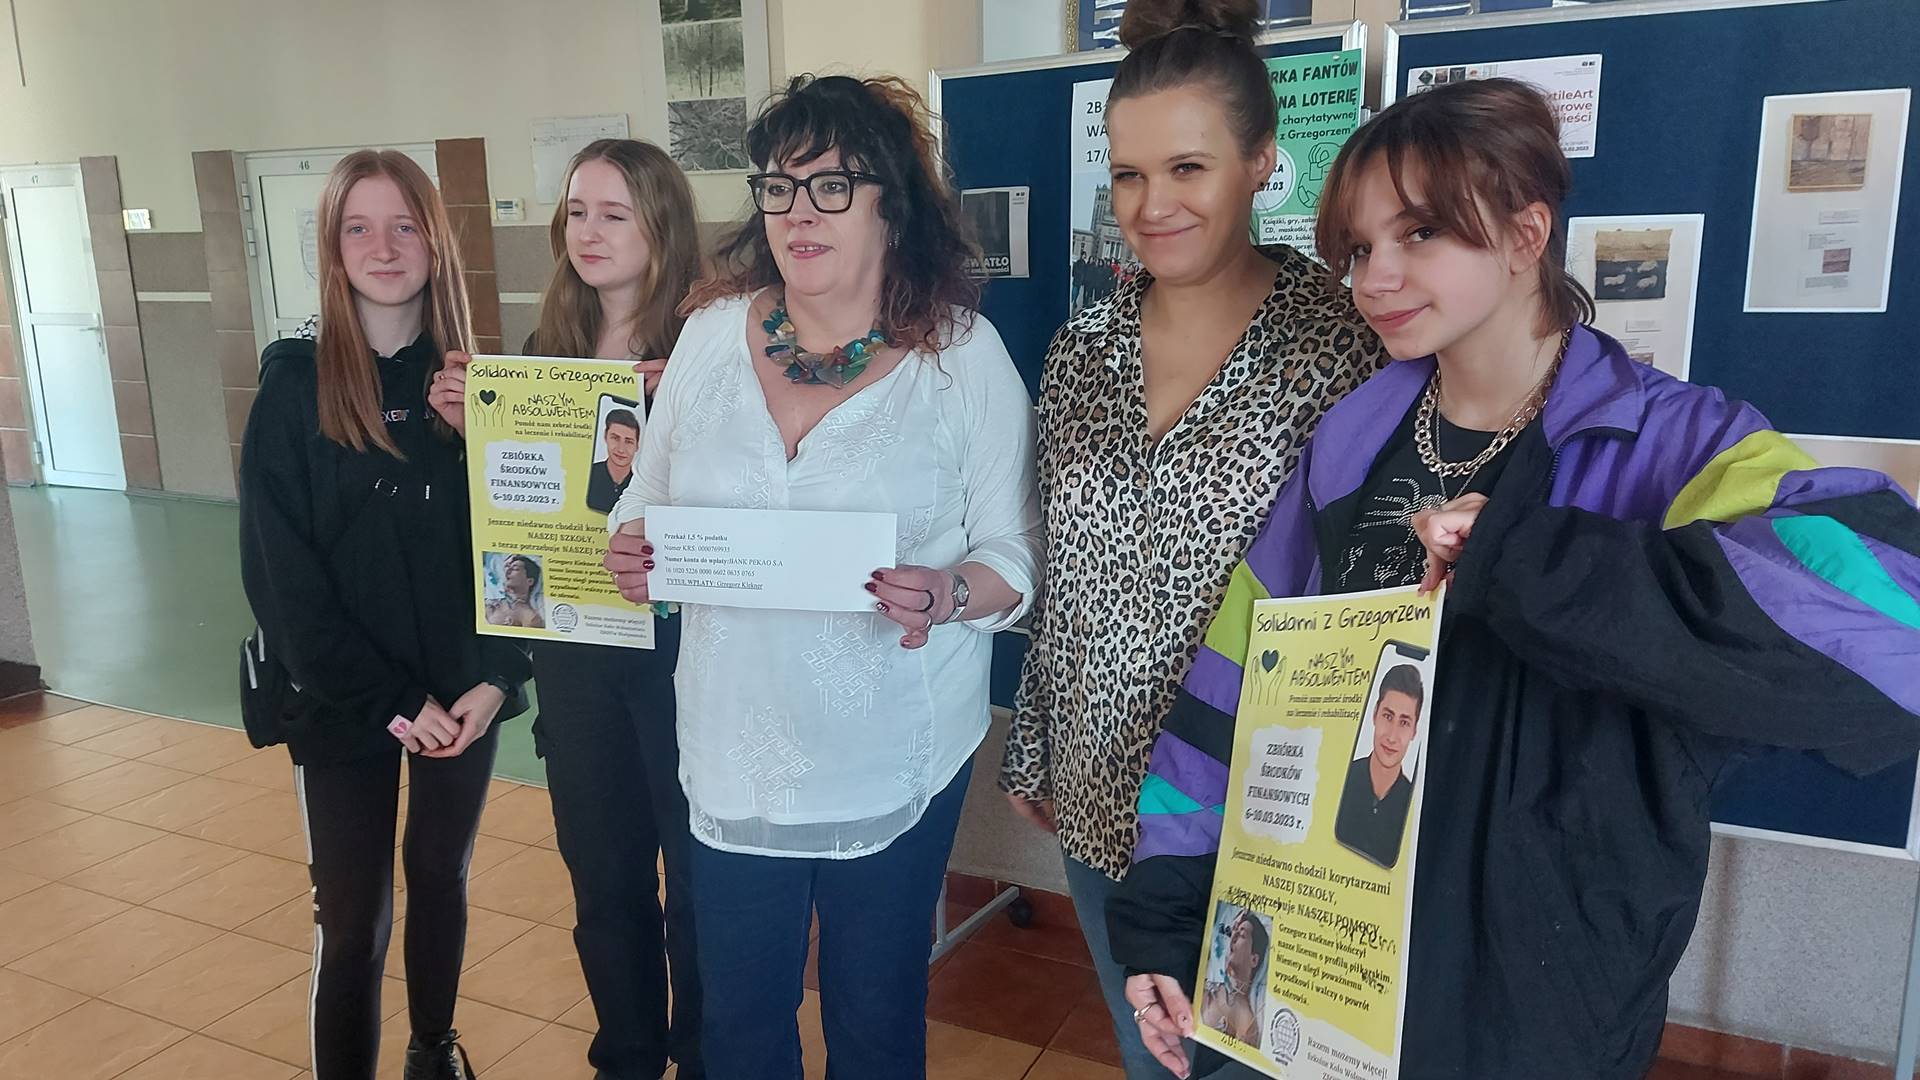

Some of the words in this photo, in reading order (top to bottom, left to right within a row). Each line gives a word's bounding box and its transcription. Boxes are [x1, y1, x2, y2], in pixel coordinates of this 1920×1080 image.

[1303, 58, 1358, 81] FANTÓW
[1279, 94, 1296, 109] NA
[1302, 88, 1357, 107] LOTERIĘ
[1283, 108, 1356, 125] charytatywnej
[298, 160, 310, 170] 46
[471, 364, 529, 379] Solidarni
[534, 368, 543, 379] z
[549, 367, 635, 392] Grzegorzem
[528, 393, 575, 406] NASZYM
[512, 403, 596, 419] ABSOLWENTEM
[502, 451, 544, 461] ZBIÓRKA
[500, 463, 548, 475] ŚRODKÓW
[490, 479, 560, 490] FINANSOWYCH
[517, 519, 553, 529] niedawno
[528, 532, 558, 542] NASZEJ
[1257, 611, 1317, 632] Solidarni
[1323, 613, 1333, 630] z
[1339, 604, 1430, 641] Grzegorzem
[1309, 647, 1354, 670] NASZYM
[1290, 668, 1371, 687] ABSOLWENTEM
[1256, 854, 1293, 872] niedawno
[1294, 861, 1326, 880] chodził
[1329, 869, 1391, 896] korytarzami
[1263, 874, 1295, 895] NASZEJ
[1297, 883, 1338, 906] SZKOŁY,
[1315, 985, 1338, 1001] walczy
[1339, 994, 1343, 1002] o
